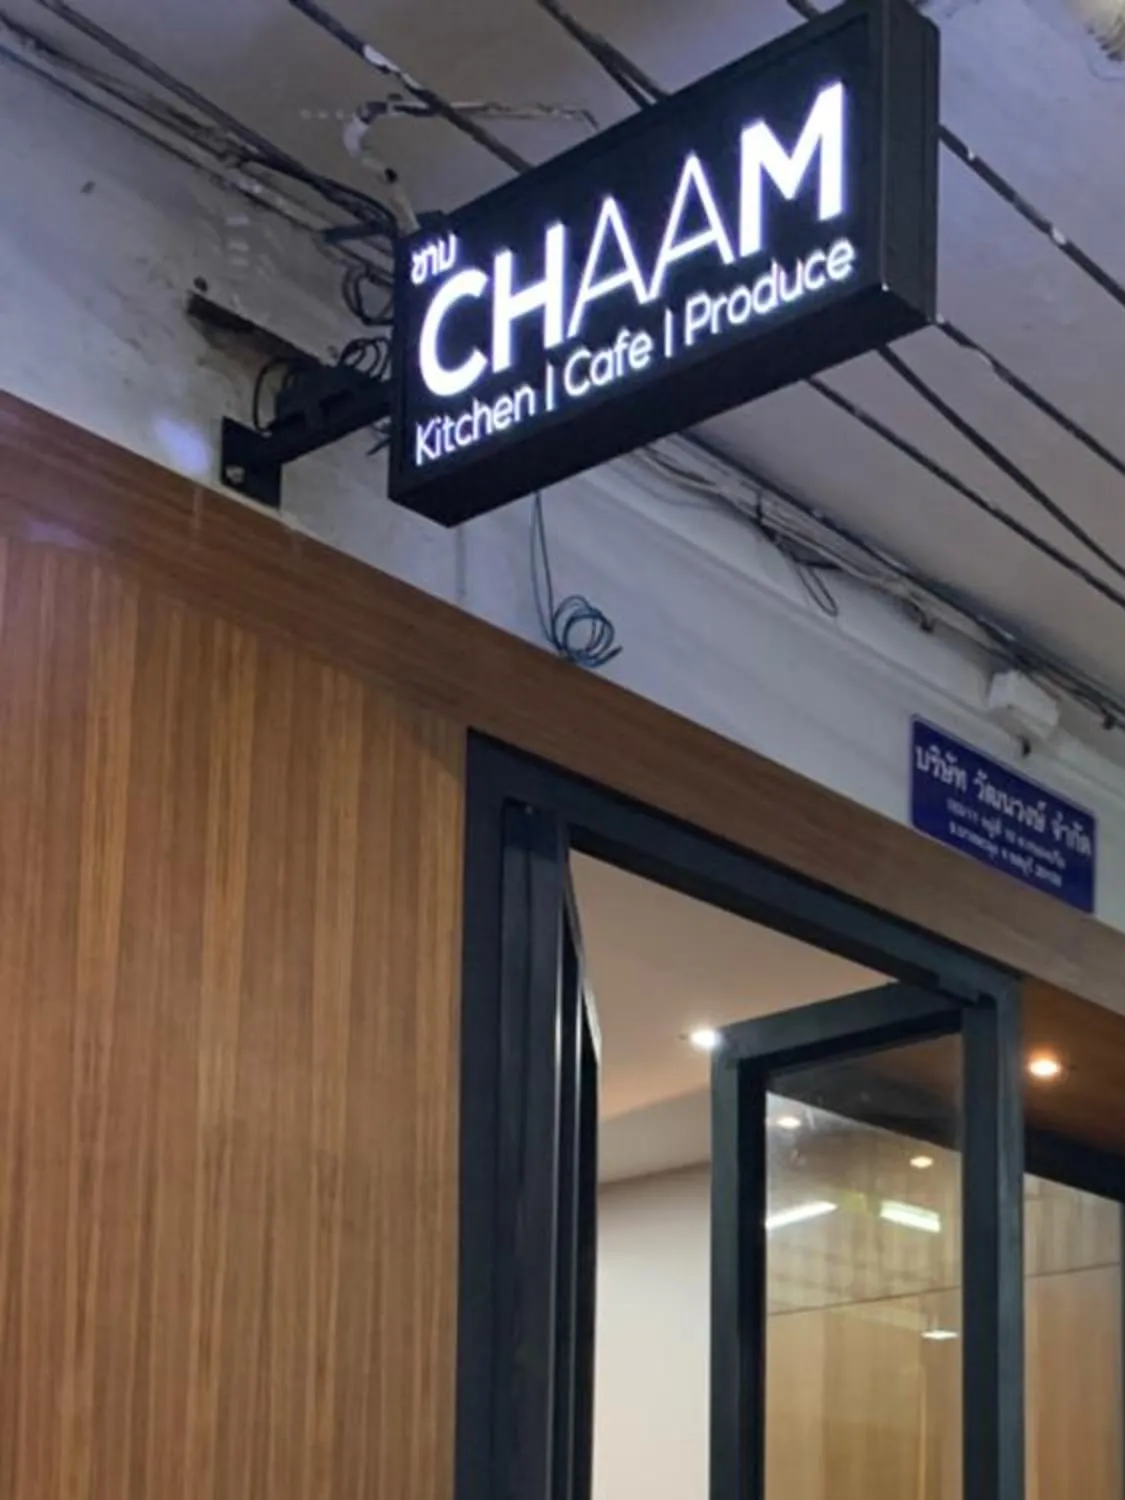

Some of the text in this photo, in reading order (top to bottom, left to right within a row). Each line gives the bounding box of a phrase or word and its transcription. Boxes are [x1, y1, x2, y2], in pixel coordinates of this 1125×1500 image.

[415, 382, 535, 467] Kitchen
[563, 325, 652, 398] Cafe
[684, 237, 855, 347] Produce
[418, 80, 844, 397] CHAAM
